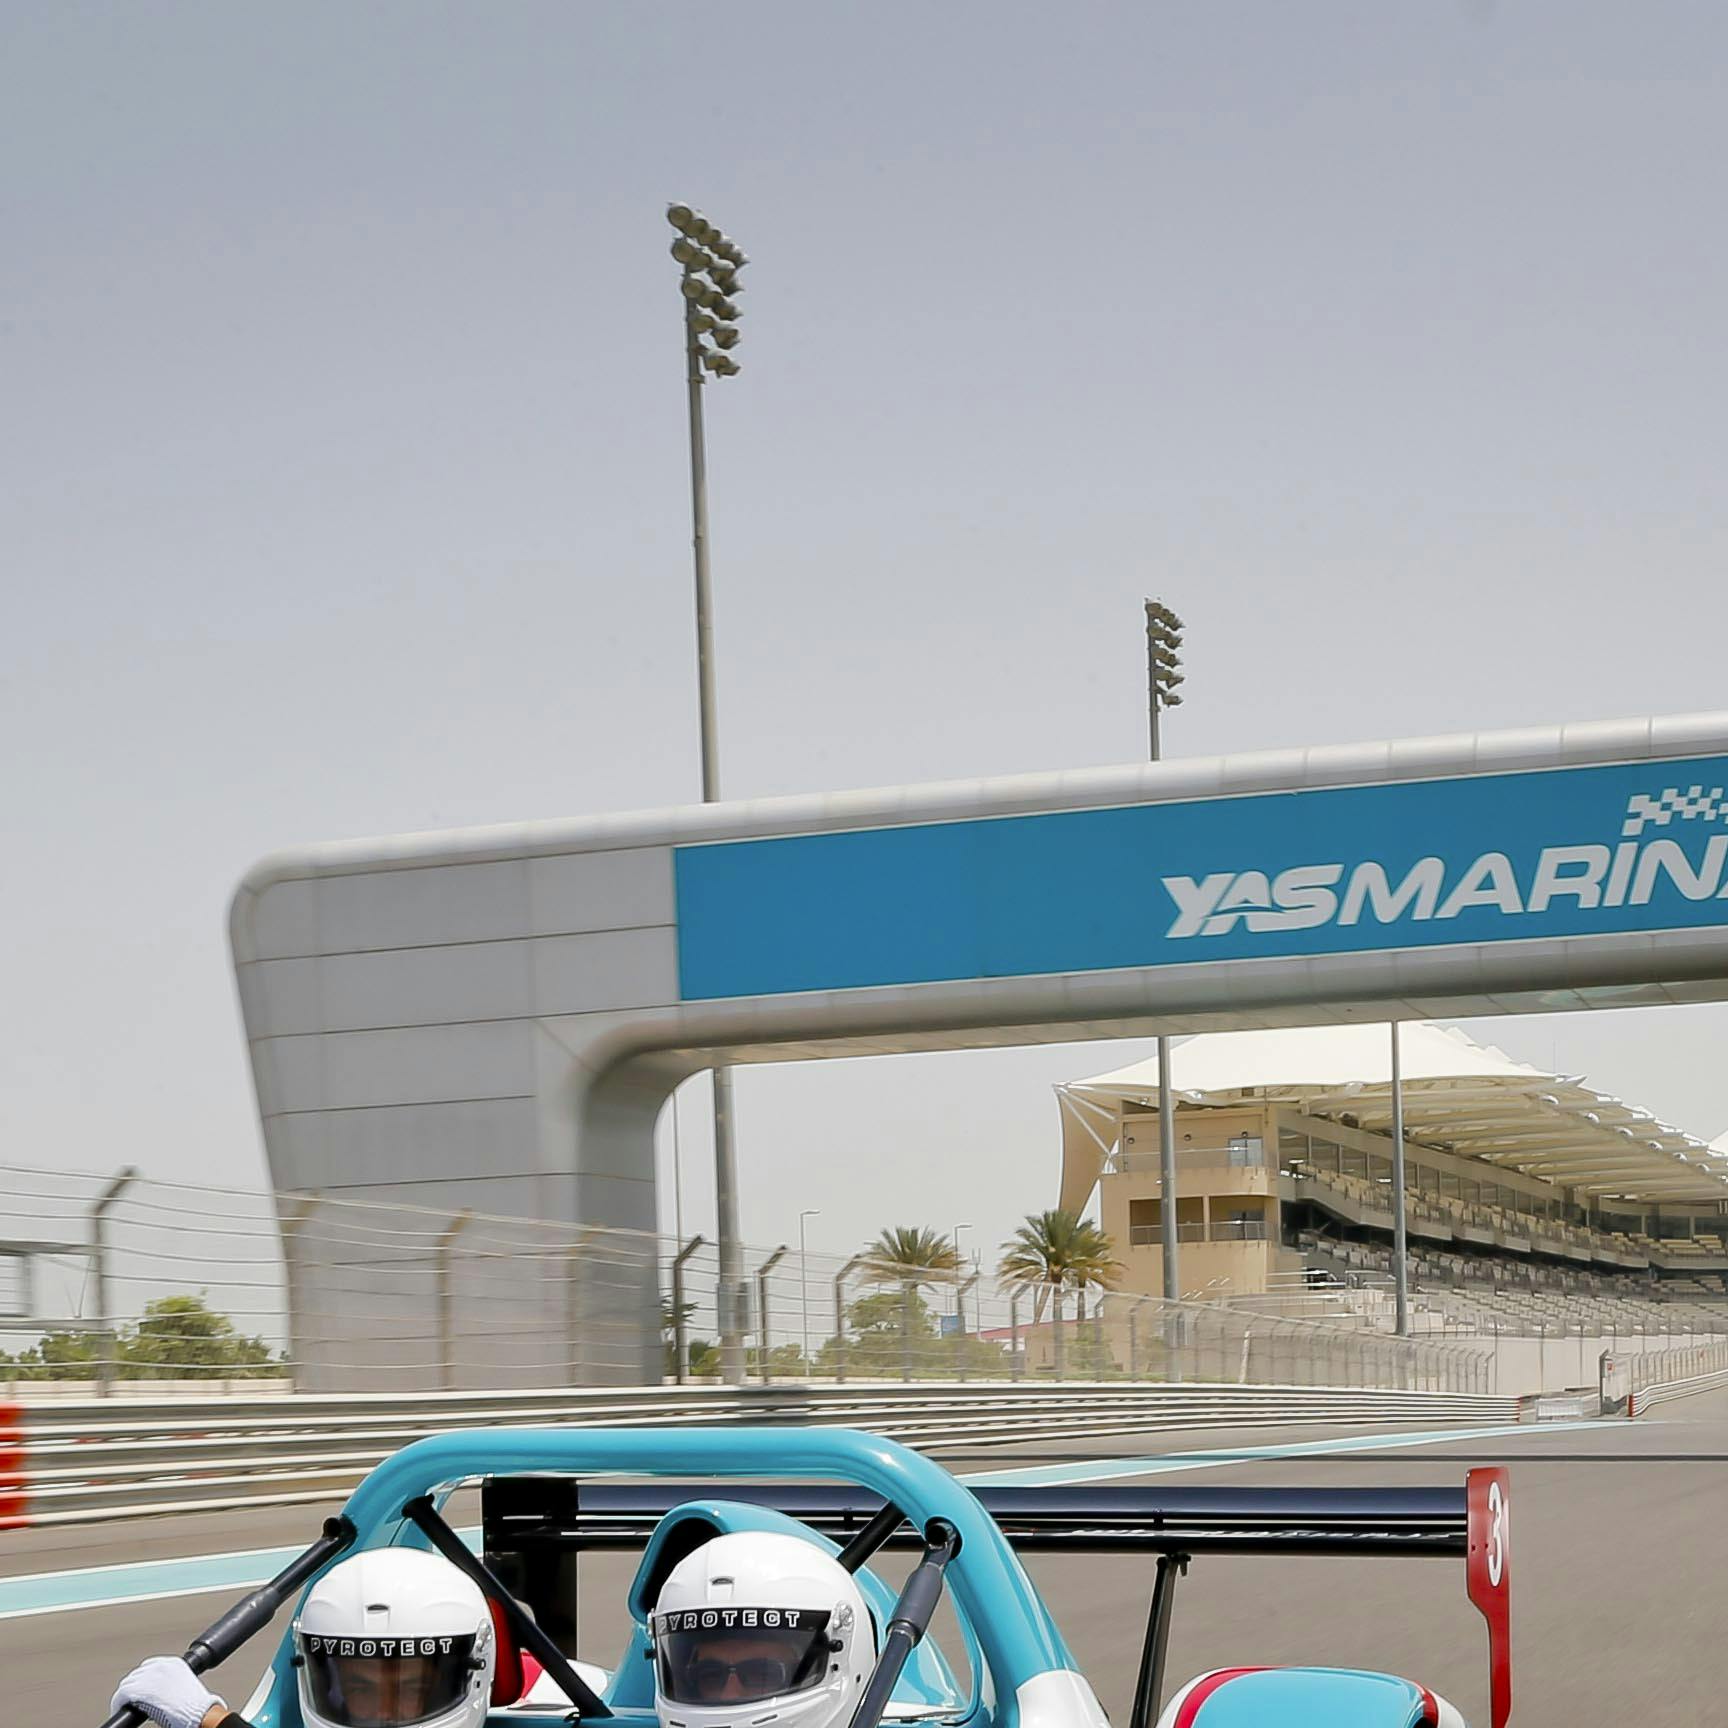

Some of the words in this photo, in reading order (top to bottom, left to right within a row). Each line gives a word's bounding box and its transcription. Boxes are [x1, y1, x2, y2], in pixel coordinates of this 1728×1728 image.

[1488, 1481, 1503, 1587] 3
[657, 1610, 800, 1636] PYROTECT
[310, 1637, 453, 1657] PYROTECT
